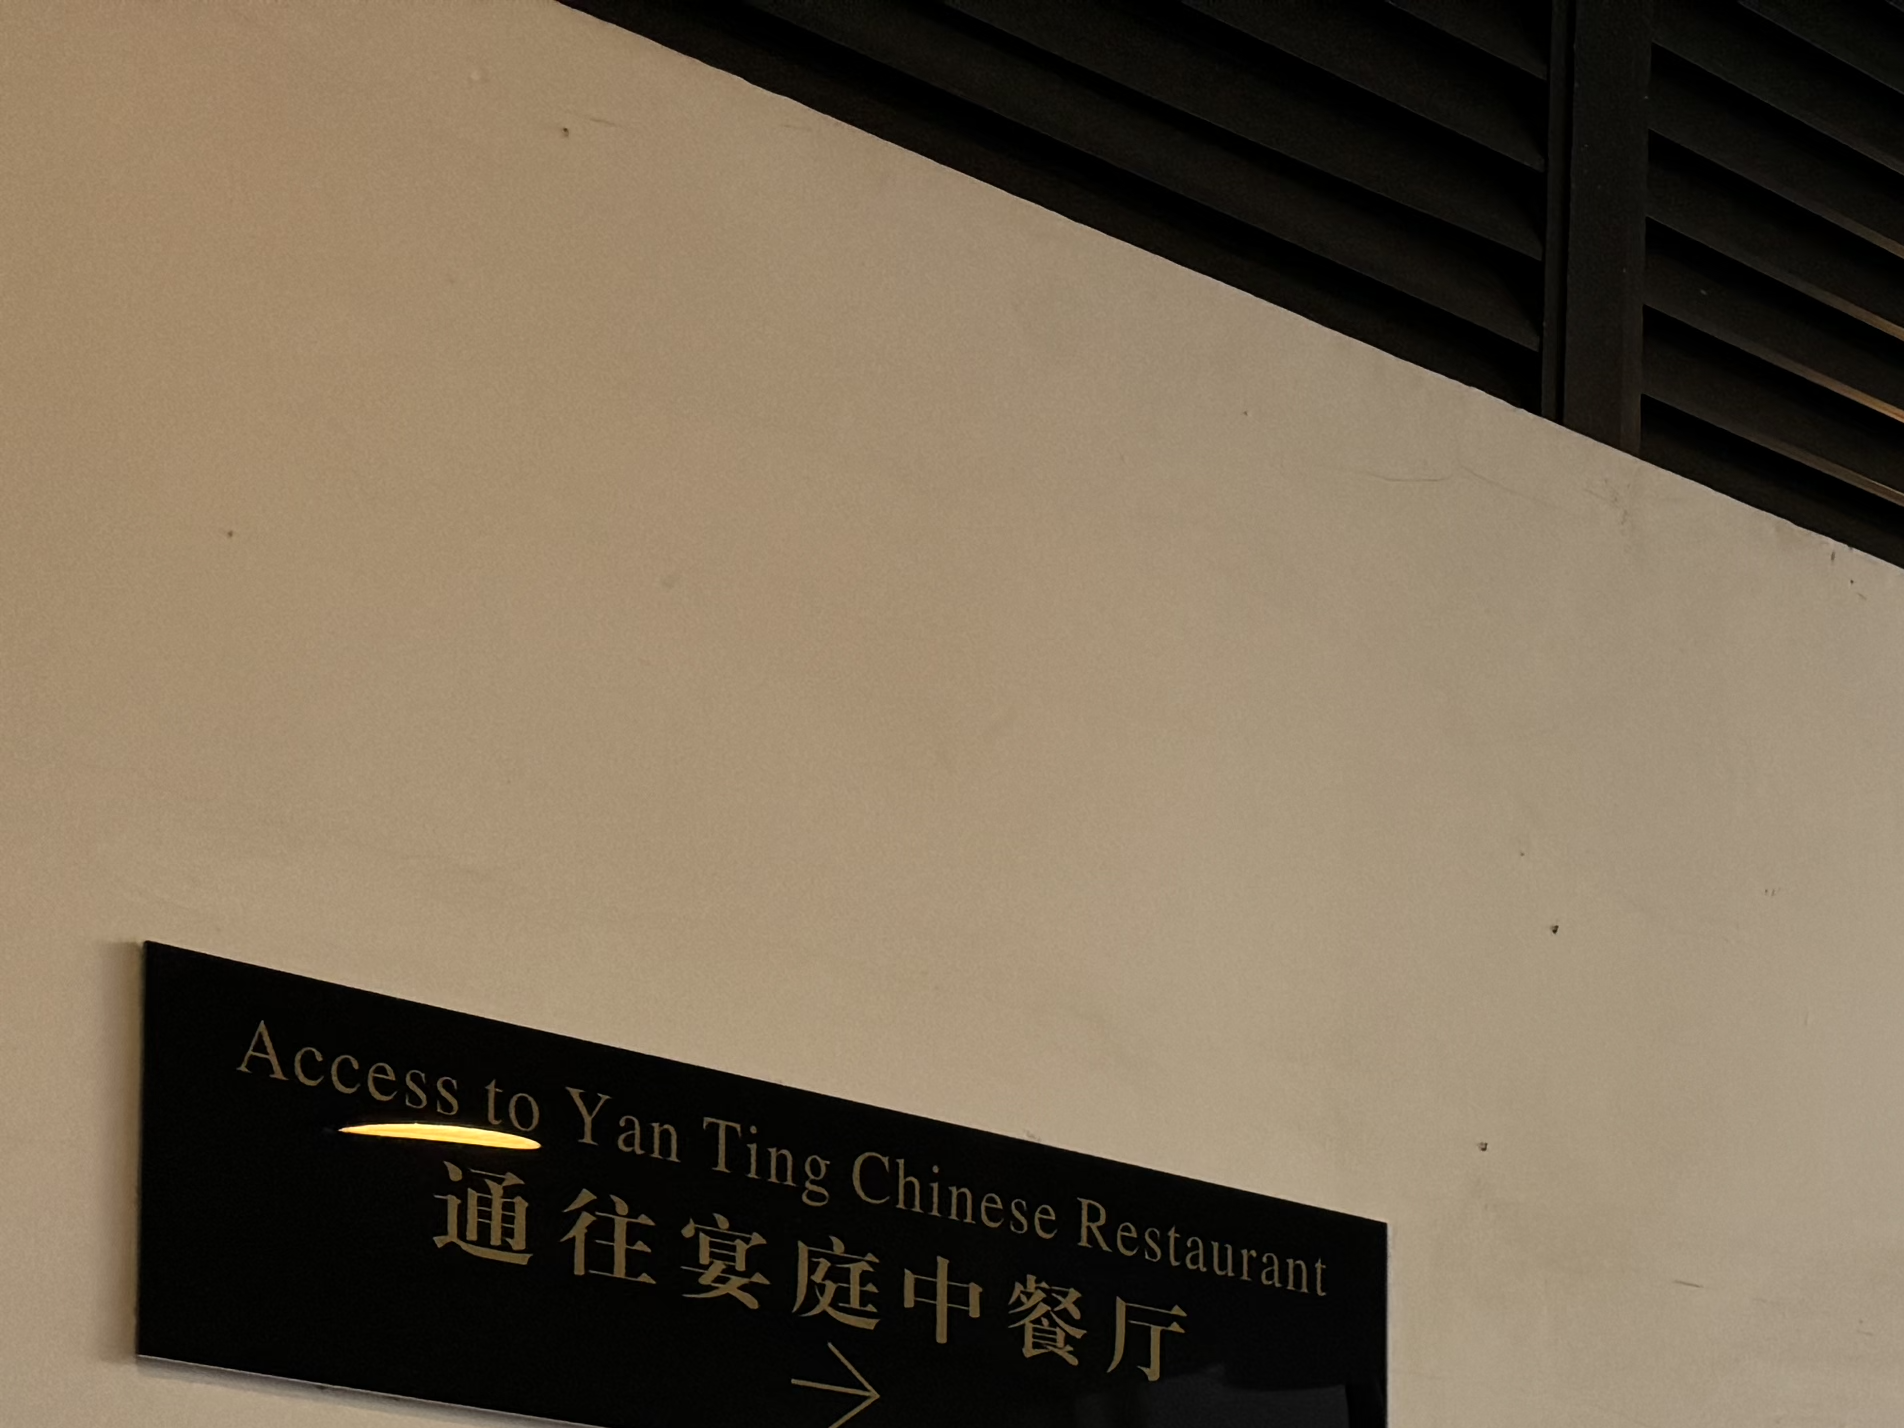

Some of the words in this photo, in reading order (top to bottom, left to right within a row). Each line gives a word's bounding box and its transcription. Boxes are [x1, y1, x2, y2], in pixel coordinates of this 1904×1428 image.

[236, 1018, 459, 1116] Access
[484, 1078, 541, 1132] to
[565, 1086, 683, 1164] Yan
[702, 1116, 830, 1207] Ting
[852, 1151, 1058, 1239] Chinese
[1077, 1197, 1328, 1297] Restaurant
[432, 1160, 1188, 1382] 通往宴庭中餐厅
